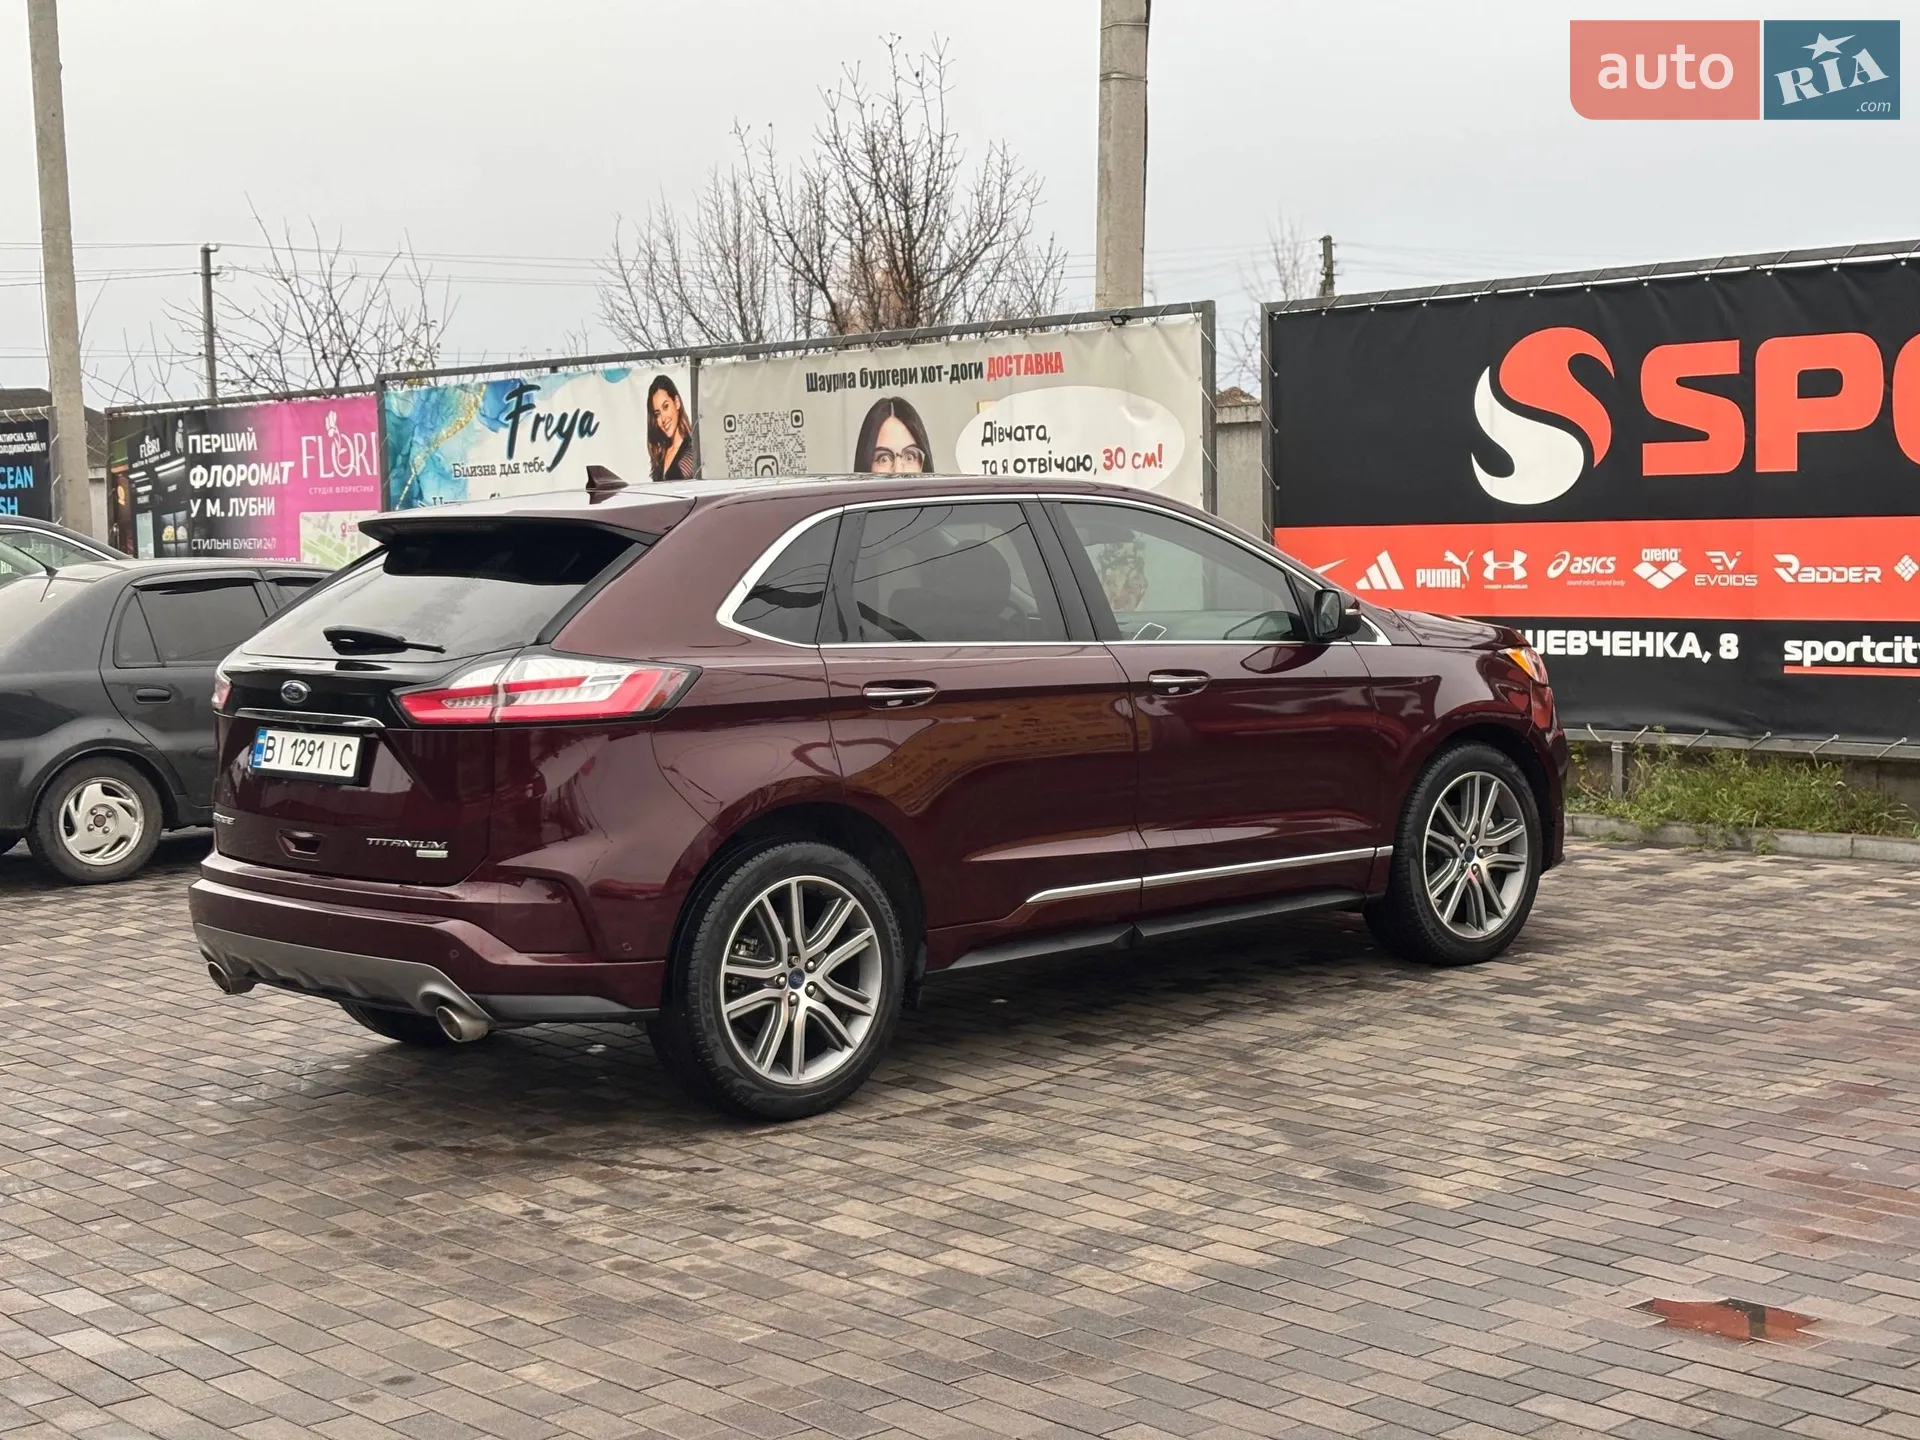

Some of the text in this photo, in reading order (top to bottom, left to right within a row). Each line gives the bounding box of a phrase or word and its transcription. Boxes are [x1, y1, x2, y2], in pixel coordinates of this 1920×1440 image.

[806, 351, 1065, 393] Шаурма бургери хот-доги ДОСТАВКА
[1641, 332, 1920, 476] SP
[188, 426, 258, 454] ПЕРШИЙ
[504, 382, 600, 473] Freya
[981, 420, 1052, 447] Дівчата,
[301, 431, 378, 479] FLORI
[982, 443, 1163, 475] та я отвічаю, 30 см!
[189, 461, 295, 489] ФЛОРОМАТ
[453, 462, 497, 479] Білизна
[499, 462, 521, 477] для
[190, 496, 276, 518] У М. ЛУБНИ
[191, 538, 232, 551] СТИЛЬНІ
[233, 537, 263, 550] БУКЕТИ
[1641, 548, 1678, 562] arena
[1415, 568, 1461, 588] PUMA
[1570, 556, 1617, 574] asics
[1694, 574, 1758, 587] EVOIDS
[1720, 633, 1739, 660] 8
[1784, 635, 1920, 667] sportcit
[264, 736, 353, 771] BI 1291 IC
[366, 837, 449, 849] TITANIUM
